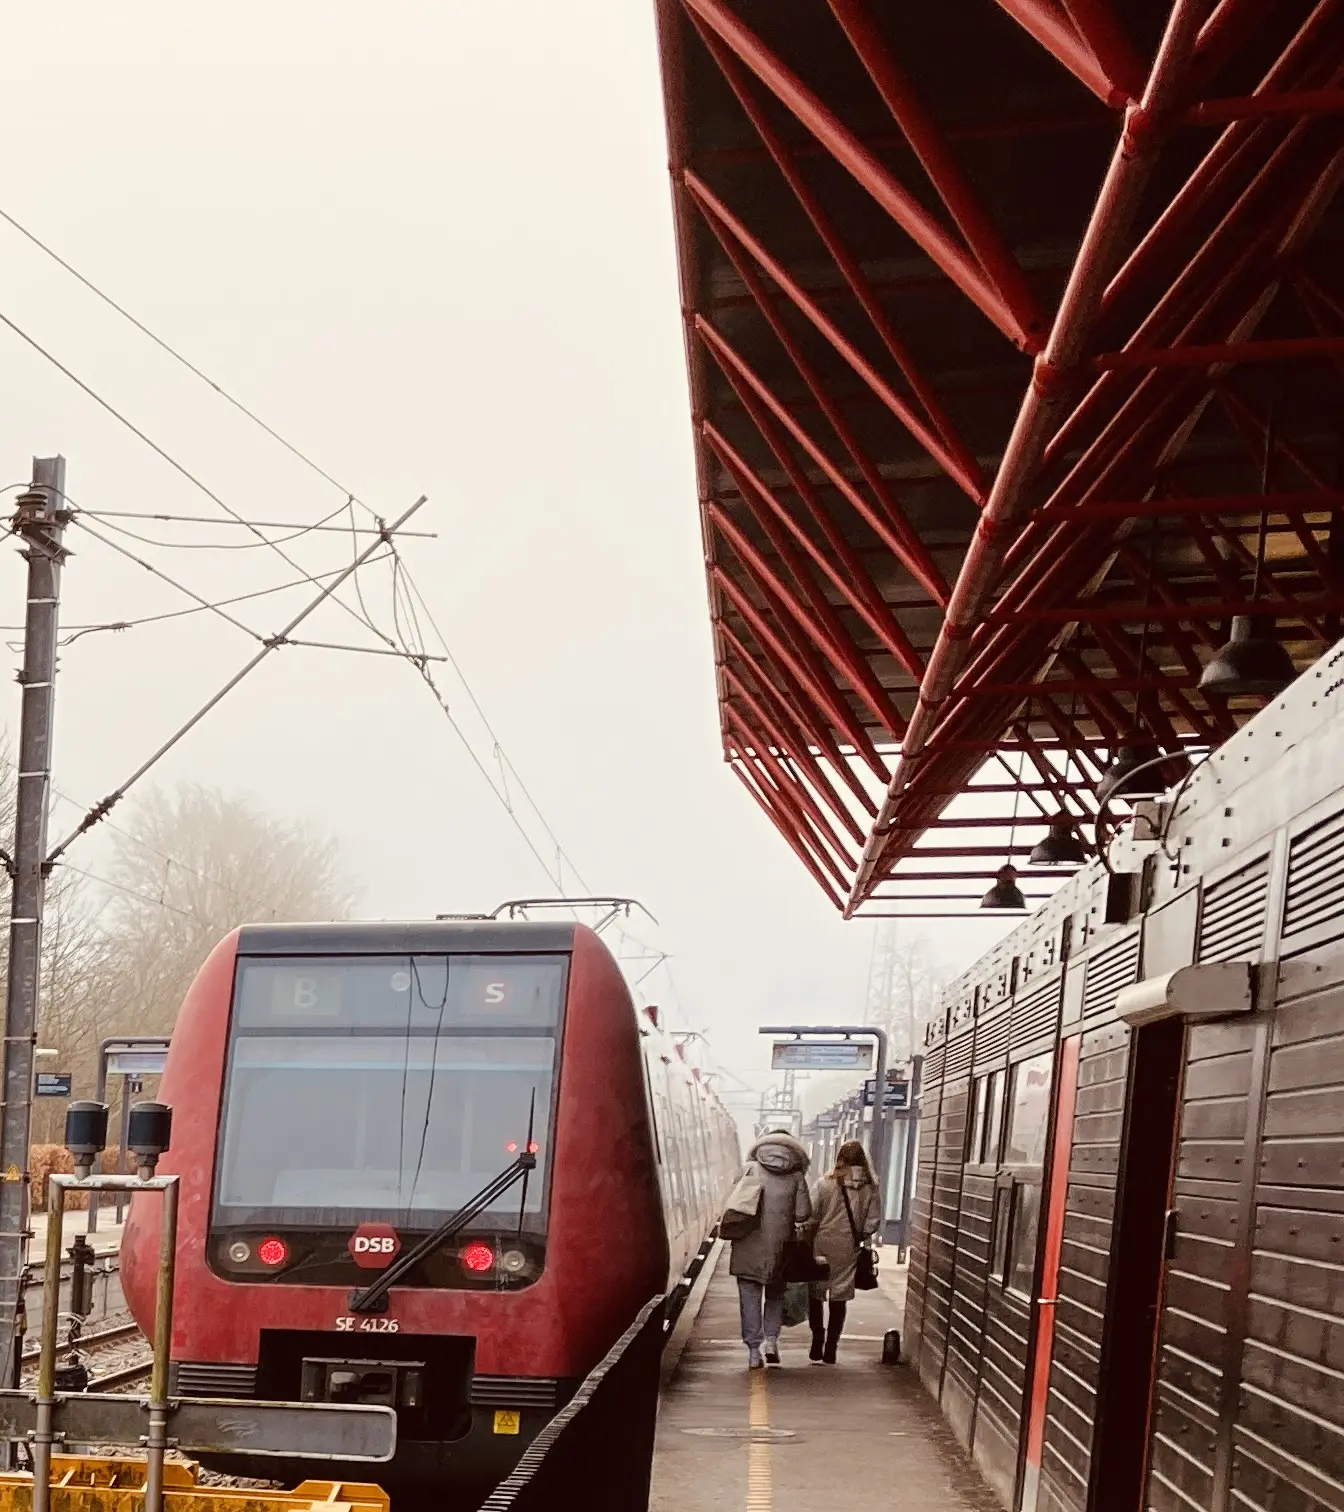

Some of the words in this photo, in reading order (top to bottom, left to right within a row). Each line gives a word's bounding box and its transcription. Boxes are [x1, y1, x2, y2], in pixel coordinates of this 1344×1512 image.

[294, 977, 319, 1007] B
[354, 1236, 395, 1253] DSB
[335, 1316, 356, 1332] SE
[360, 1317, 399, 1333] 4126
